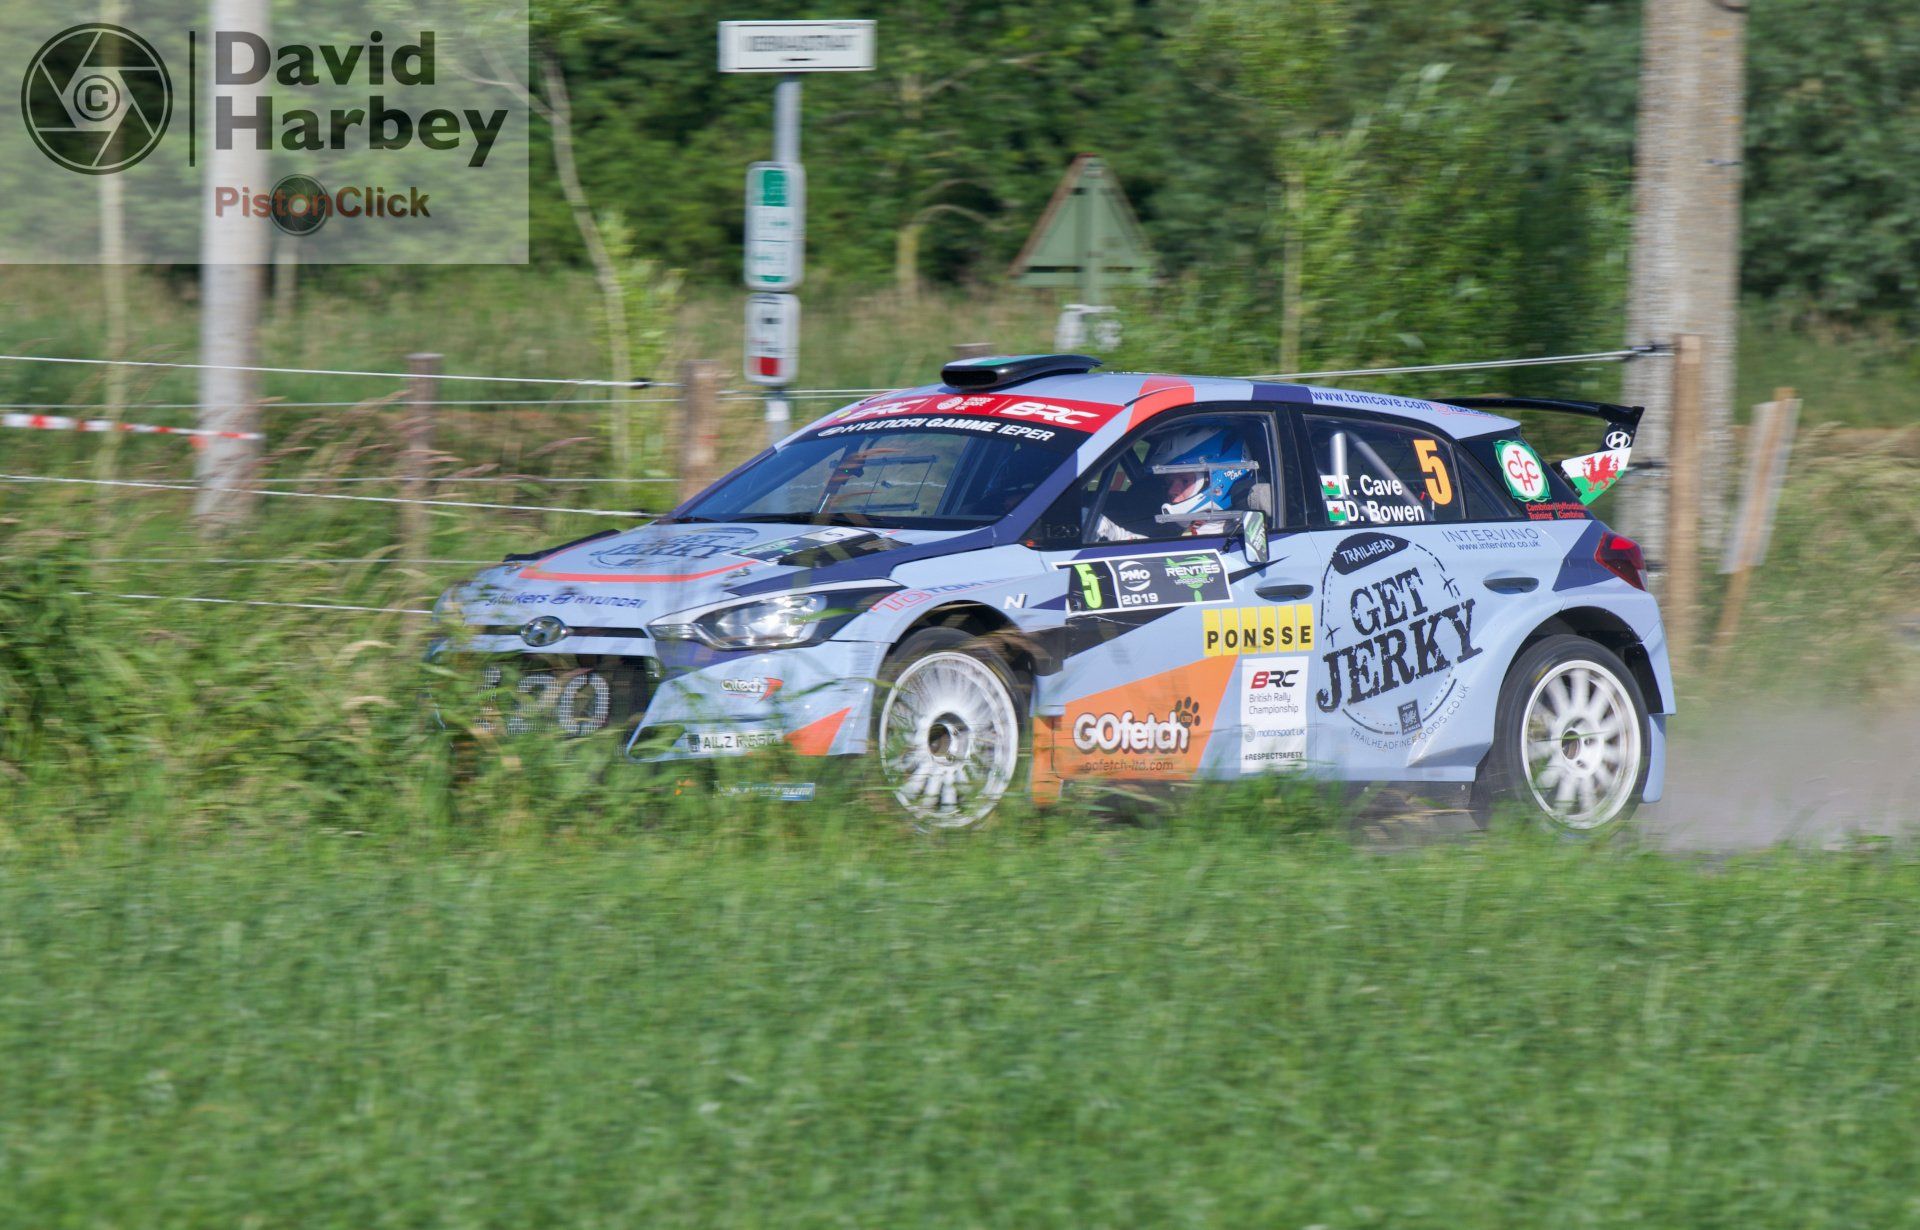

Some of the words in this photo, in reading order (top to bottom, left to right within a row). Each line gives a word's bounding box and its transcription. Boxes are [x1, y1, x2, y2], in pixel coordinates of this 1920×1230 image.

[1311, 390, 1433, 411] www.tomcave.com
[1000, 402, 1100, 425] BRC
[841, 418, 928, 434] HYUNDAI
[926, 417, 1001, 432] GAMME
[997, 422, 1056, 442] IEPER
[1413, 439, 1453, 506] 5
[1360, 474, 1403, 496] Cave
[1344, 500, 1365, 522] D.
[1366, 500, 1426, 522] Bowen
[1441, 527, 1540, 543] INTERVINO
[1339, 538, 1396, 565] TRAILHEAD
[1119, 569, 1151, 582] PMO
[1165, 563, 1221, 577] RENTIES
[1074, 563, 1102, 609] 5
[1121, 592, 1159, 605] 2019
[1350, 567, 1428, 636] GET
[1207, 625, 1312, 650] PONSSE
[1315, 598, 1484, 713] JERKY
[1250, 670, 1300, 689] BRC
[1249, 693, 1273, 703] British
[1273, 692, 1292, 703] Rally
[1248, 704, 1300, 716] Championship
[1073, 710, 1190, 753] GOfetch
[1245, 751, 1304, 761] #RESPECTSAFETY
